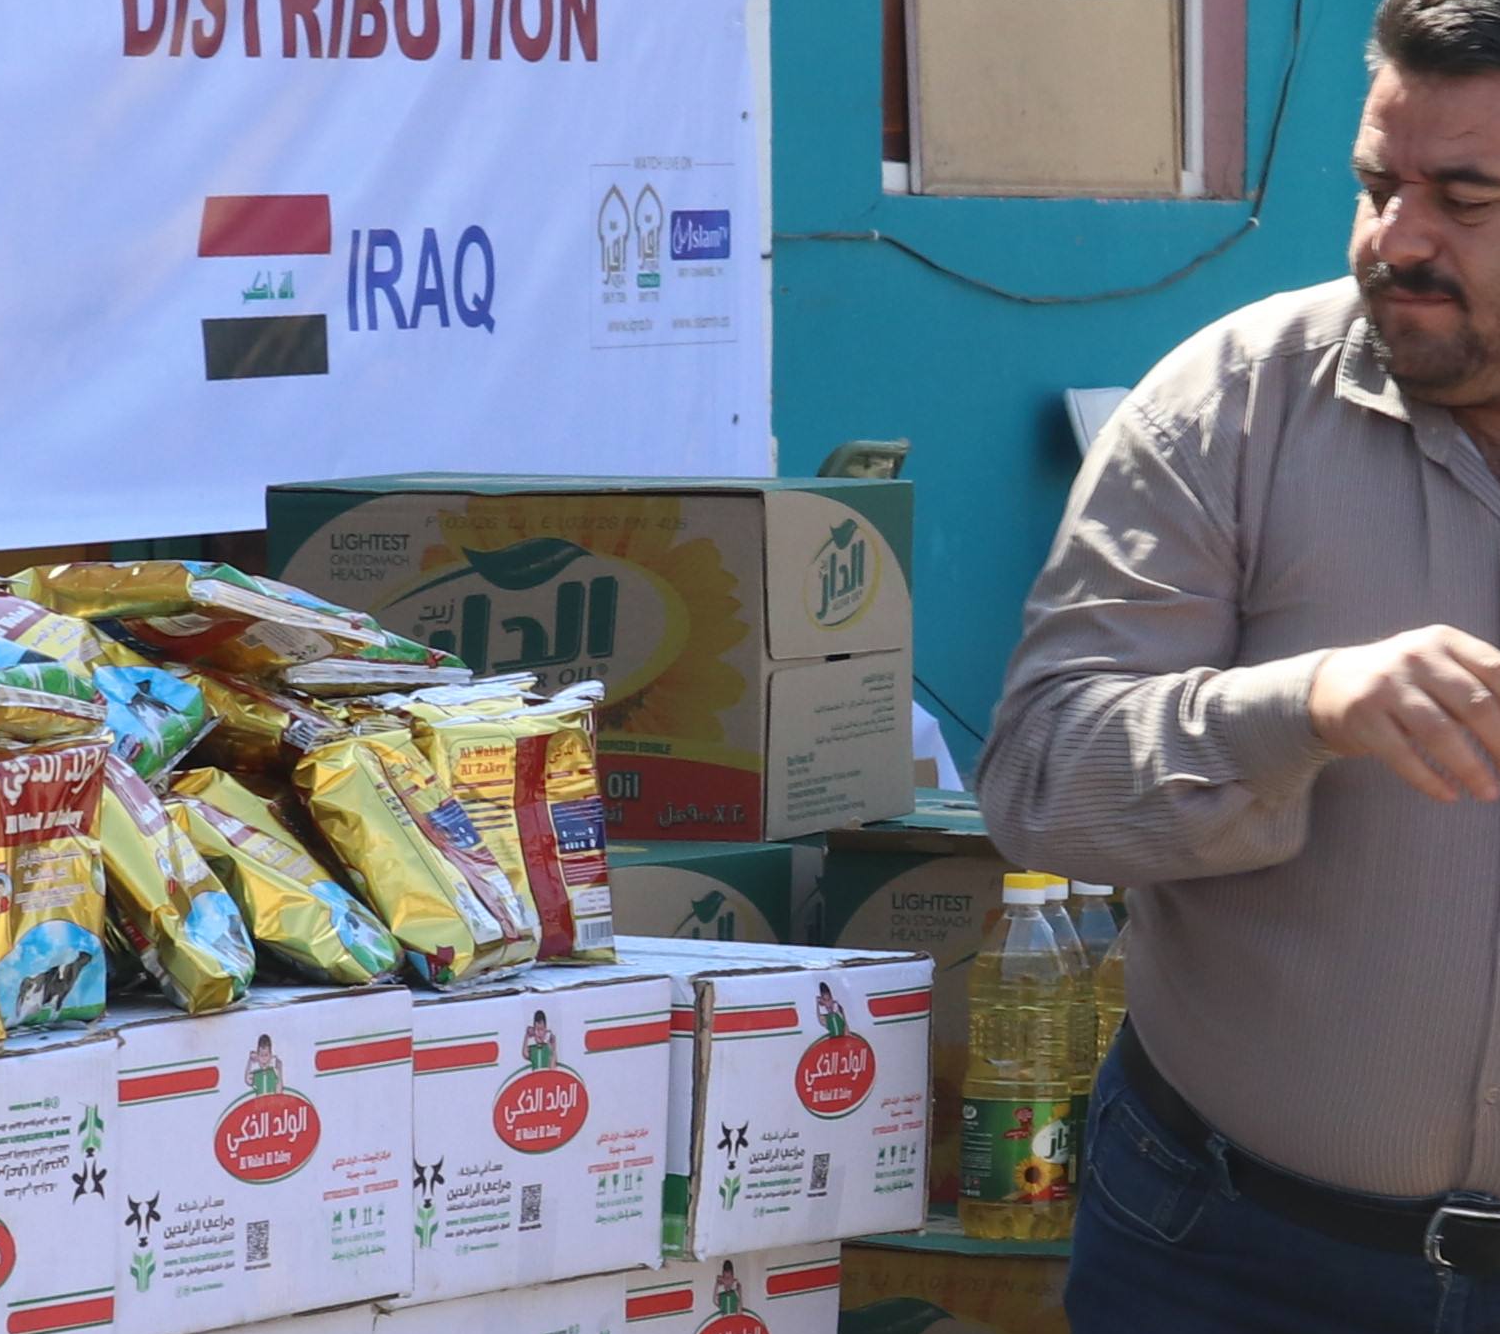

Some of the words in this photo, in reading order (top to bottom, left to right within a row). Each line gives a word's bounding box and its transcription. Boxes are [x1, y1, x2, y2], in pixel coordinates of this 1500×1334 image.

[348, 223, 496, 334] IRAQ
[330, 534, 410, 551] LIGHTEST
[330, 554, 349, 566] ON
[351, 554, 410, 567] STOMACH
[330, 569, 386, 582] HEALTHY
[815, 539, 866, 619] الدار
[608, 772, 640, 799] Oil
[891, 895, 974, 913] LIGHTEST
[504, 1087, 542, 1130] الذكي
[545, 1083, 578, 1117] الولد
[227, 1113, 269, 1158] الذكي
[273, 1106, 307, 1142] الولد
